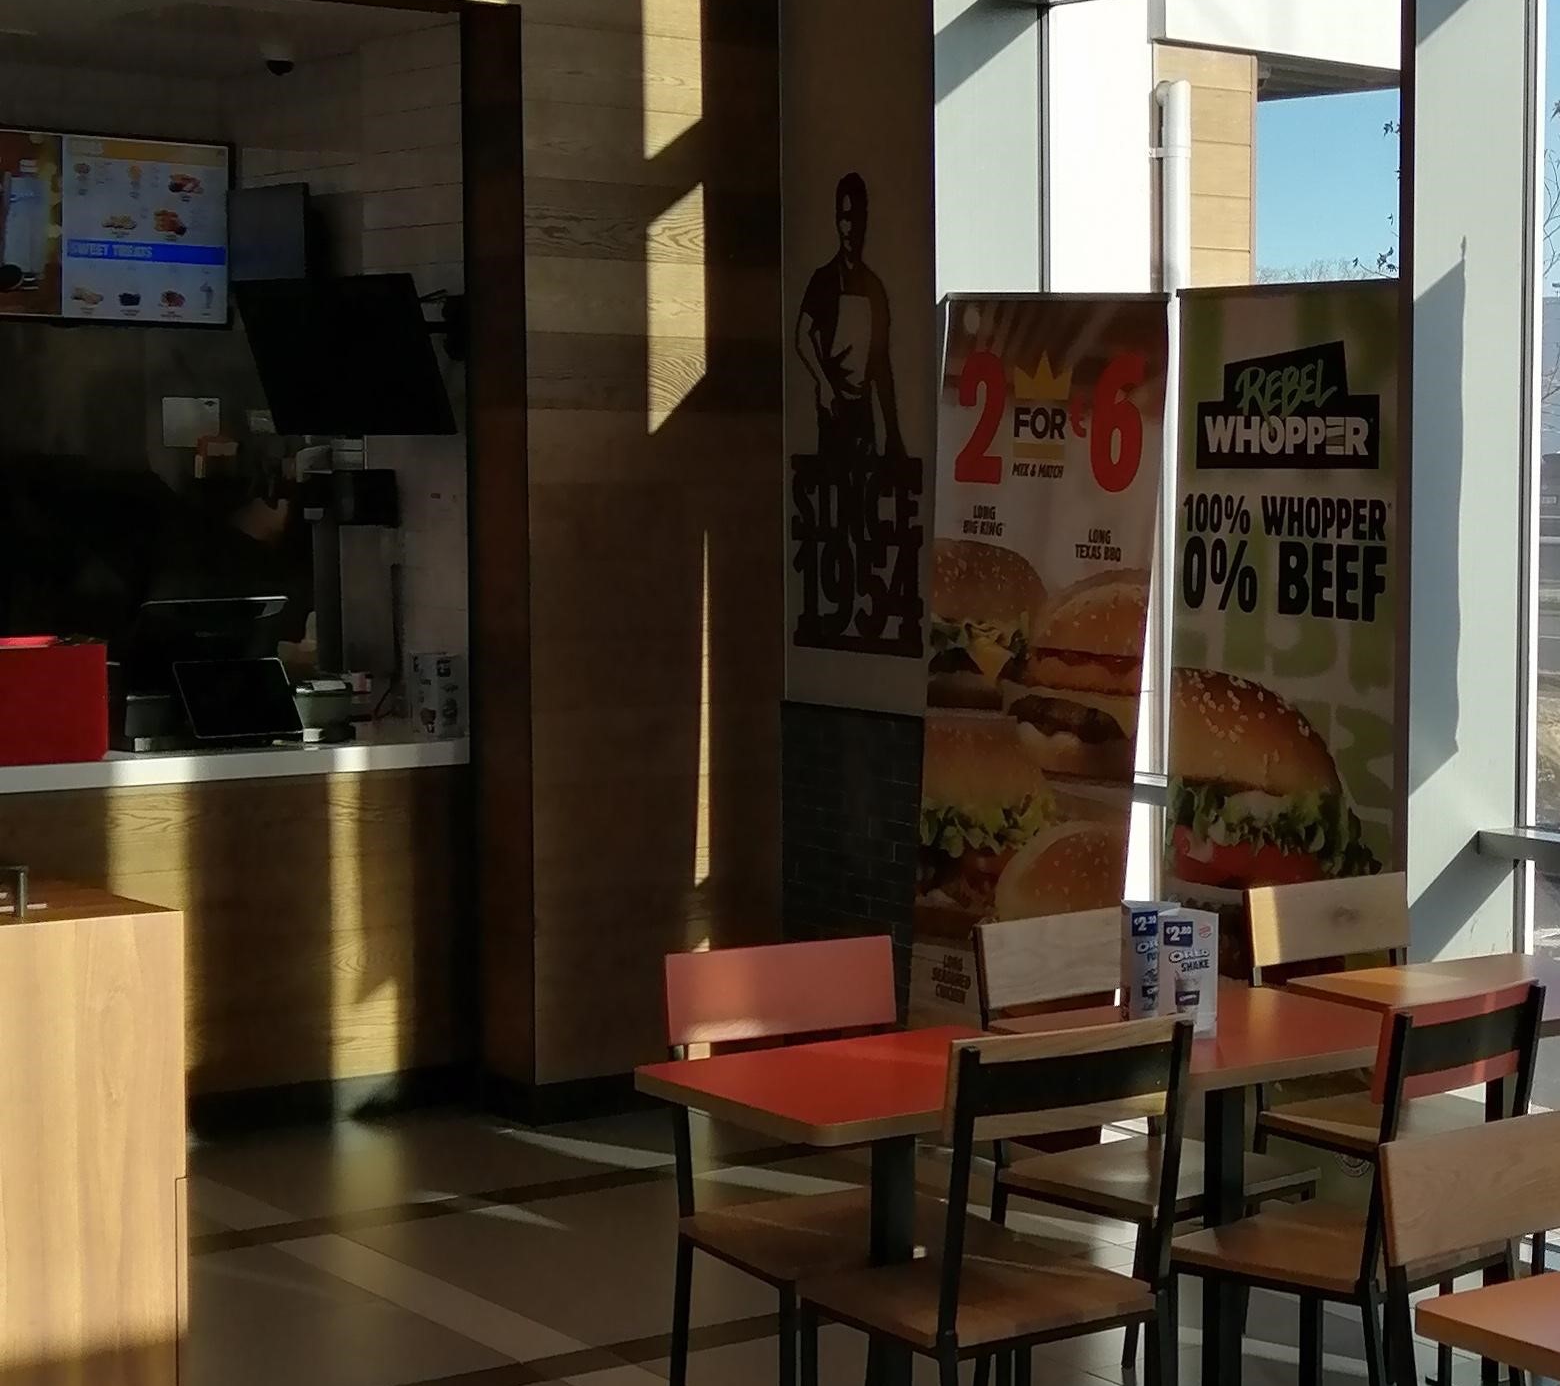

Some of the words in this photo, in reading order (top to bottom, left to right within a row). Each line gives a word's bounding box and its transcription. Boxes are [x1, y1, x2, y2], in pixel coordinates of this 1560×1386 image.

[1234, 358, 1338, 417] REBEL
[954, 351, 1007, 484] 2
[1014, 406, 1067, 440] FOR
[1205, 415, 1369, 456] WHOPPER
[1012, 463, 1029, 477] MIX
[1030, 464, 1037, 477] &
[1039, 464, 1064, 478] MATCH
[791, 454, 923, 544] SINCE
[973, 505, 995, 520] LONG
[1183, 493, 1251, 535] 100%
[963, 520, 978, 534] BIG
[980, 521, 1003, 536] KING
[1088, 529, 1111, 544] LONG
[1075, 544, 1102, 560] TEXAS
[1104, 546, 1122, 562] BBQ
[793, 541, 923, 657] 1954
[1183, 536, 1257, 613] 0%
[1279, 541, 1387, 622] BEEF
[1181, 960, 1210, 973] SHAKE
